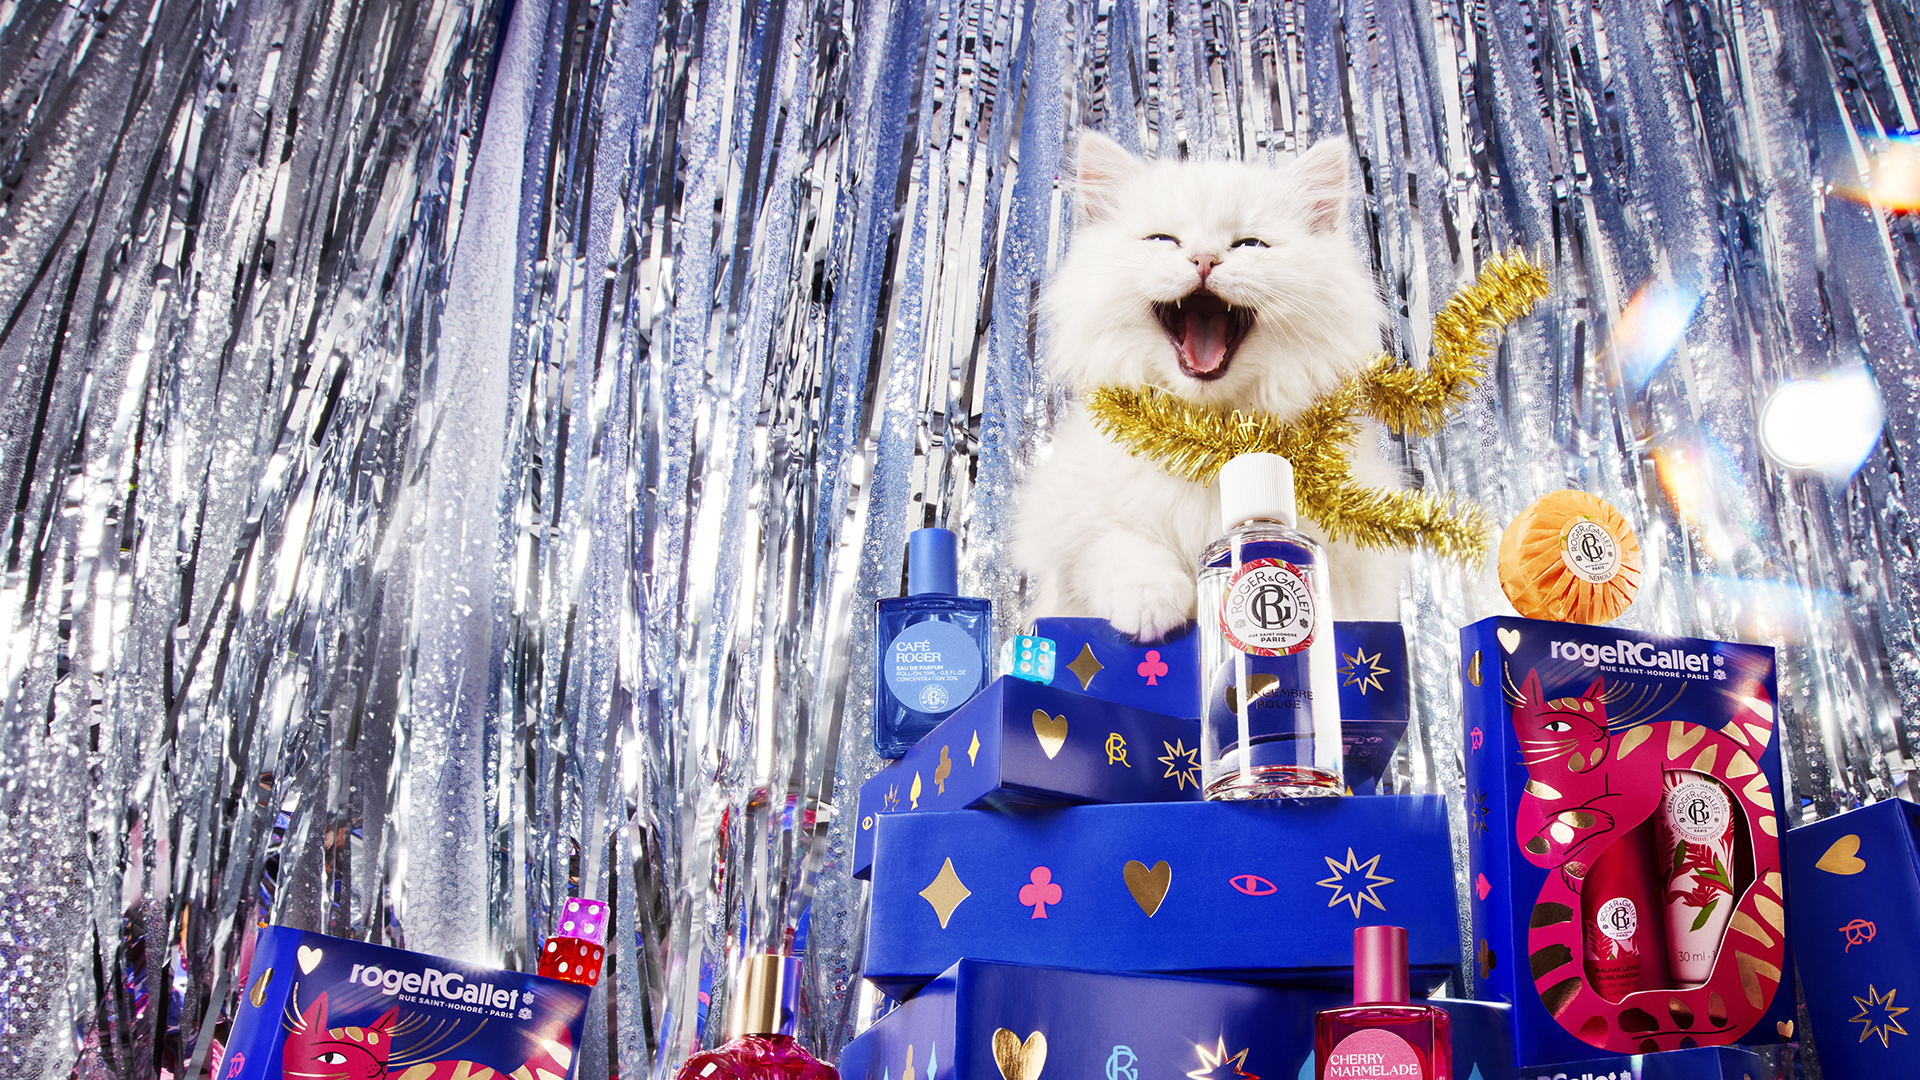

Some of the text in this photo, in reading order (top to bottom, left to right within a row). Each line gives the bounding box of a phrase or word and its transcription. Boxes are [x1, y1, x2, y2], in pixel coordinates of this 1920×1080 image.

[896, 640, 930, 652] CAFÉ
[896, 652, 941, 662] ROGER
[1550, 639, 1710, 672] rogeRGallet
[1619, 666, 1680, 678] SAINT-HONORÉ
[1687, 673, 1710, 681] PARIS
[1256, 700, 1301, 709] ROUGE
[1679, 951, 1690, 962] 30
[1693, 951, 1705, 961] ml
[349, 963, 519, 1010] rogeRGallet
[399, 994, 514, 1019] RUE SAINT-HONORÉ PARIS
[1330, 1053, 1385, 1065] CHERRY
[1330, 1064, 1418, 1077] MARMELADE
